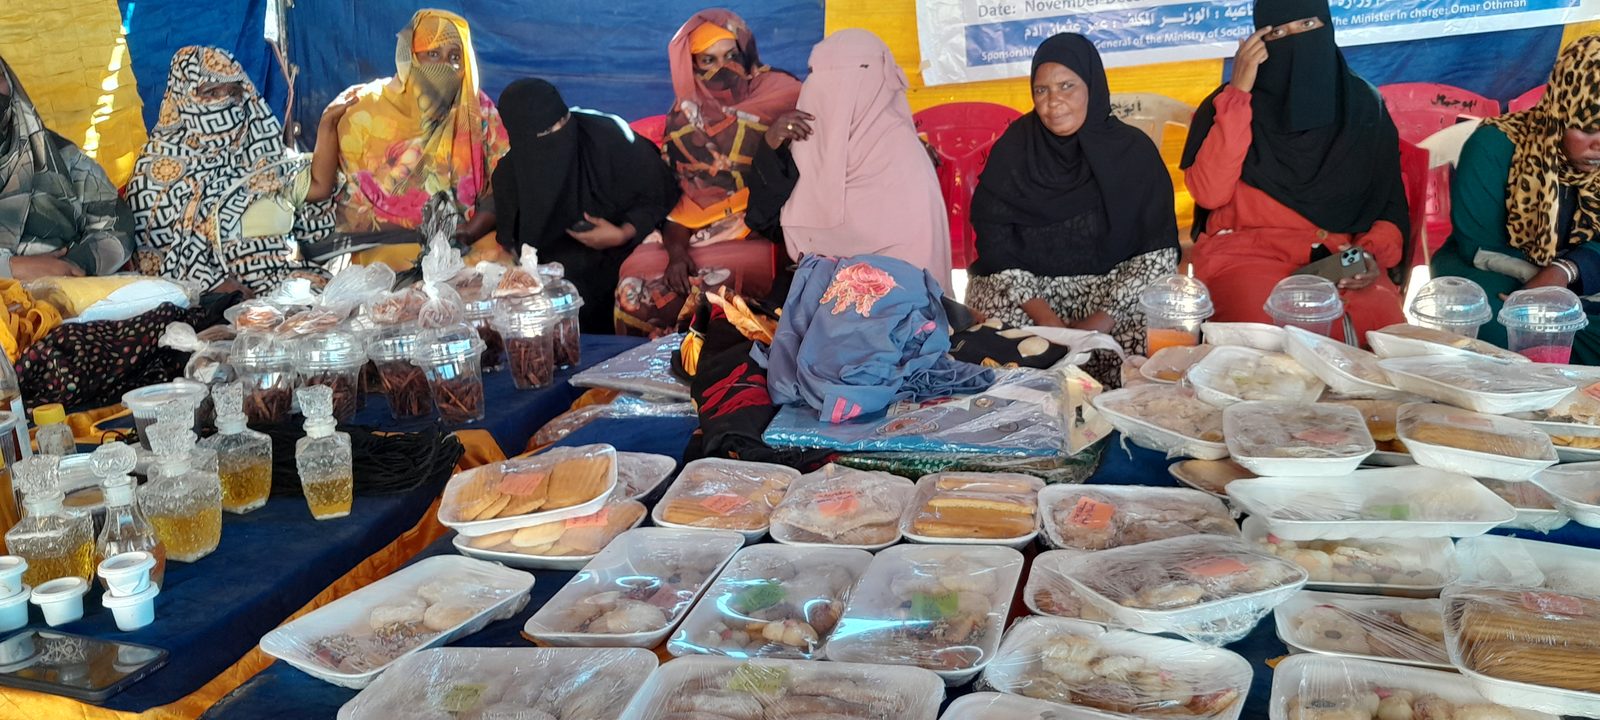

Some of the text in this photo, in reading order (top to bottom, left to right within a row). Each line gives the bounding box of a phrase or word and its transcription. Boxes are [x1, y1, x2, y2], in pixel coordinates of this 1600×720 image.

[978, 4, 1016, 18] Date:
[1159, 6, 1210, 28] الوزير
[1351, 12, 1396, 25] Minister
[1397, 11, 1407, 20] in
[1410, 7, 1449, 20] charge:
[1451, 4, 1480, 14] Omar
[1483, 0, 1527, 10] Othman
[1094, 36, 1131, 49] General
[1133, 35, 1143, 46] of
[1146, 33, 1163, 44] the
[1165, 30, 1206, 42] Ministry
[1207, 27, 1219, 39] of
[1221, 25, 1250, 38] Social
